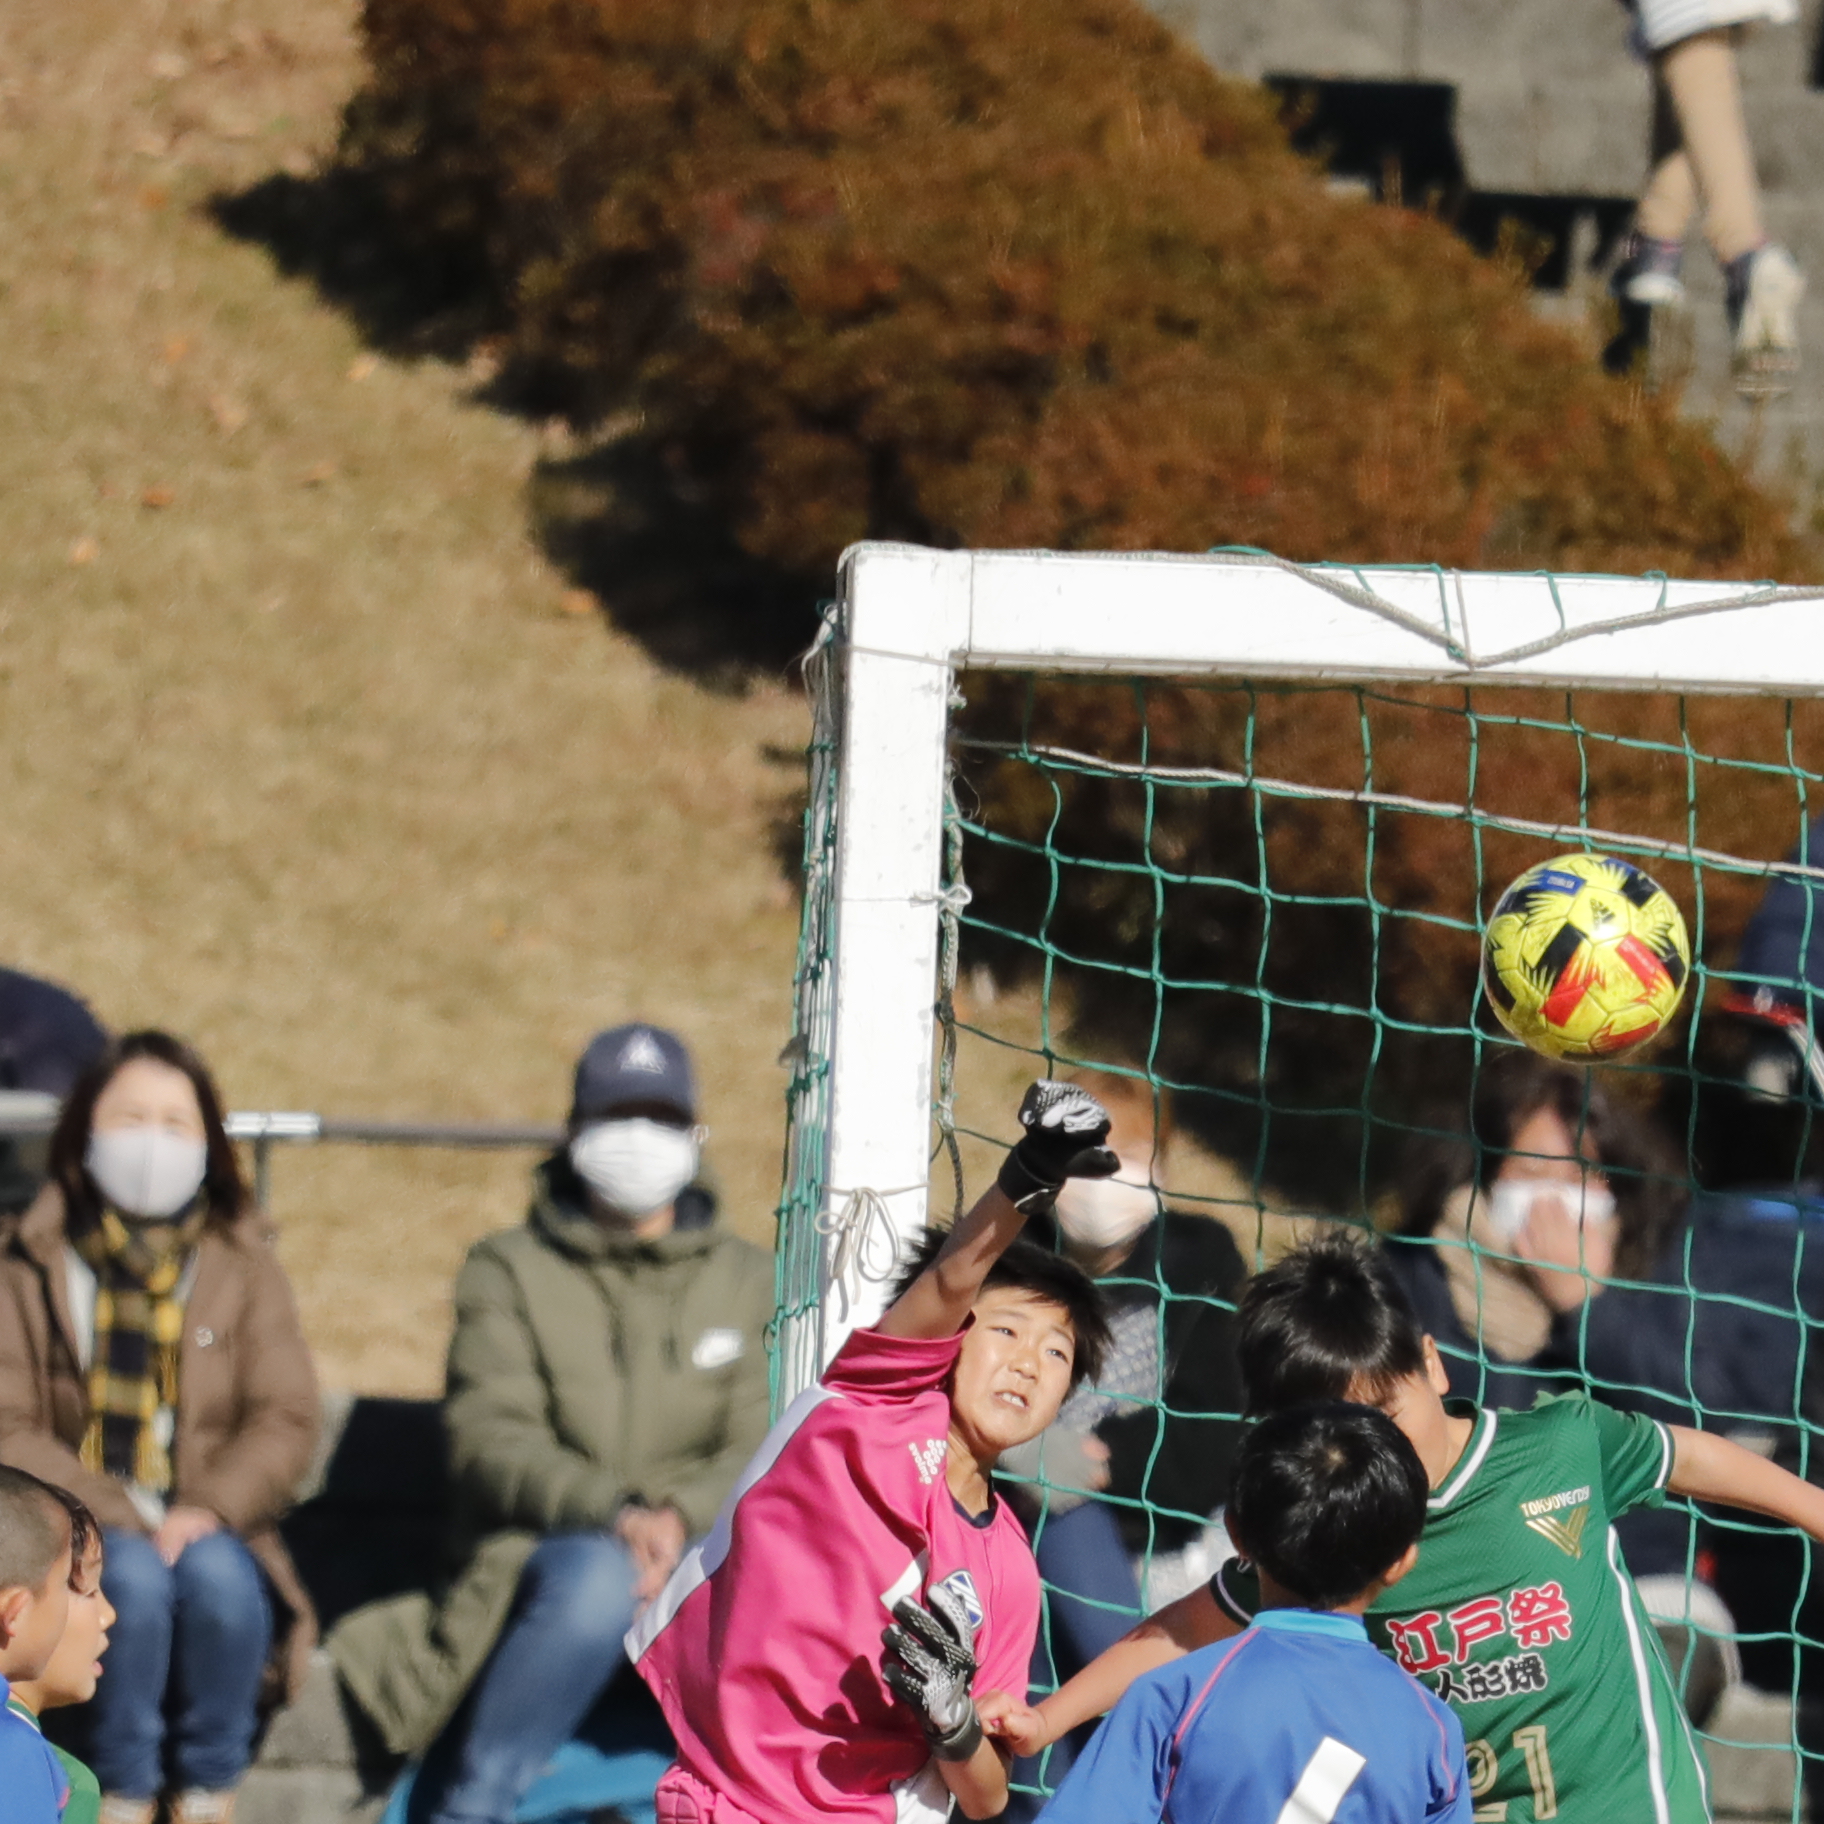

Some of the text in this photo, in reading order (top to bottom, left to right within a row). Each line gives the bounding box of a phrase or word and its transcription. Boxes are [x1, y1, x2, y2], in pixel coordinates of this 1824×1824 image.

[1386, 1581, 1572, 1674] 江戸祭
[1465, 1725, 1557, 1822] 21
